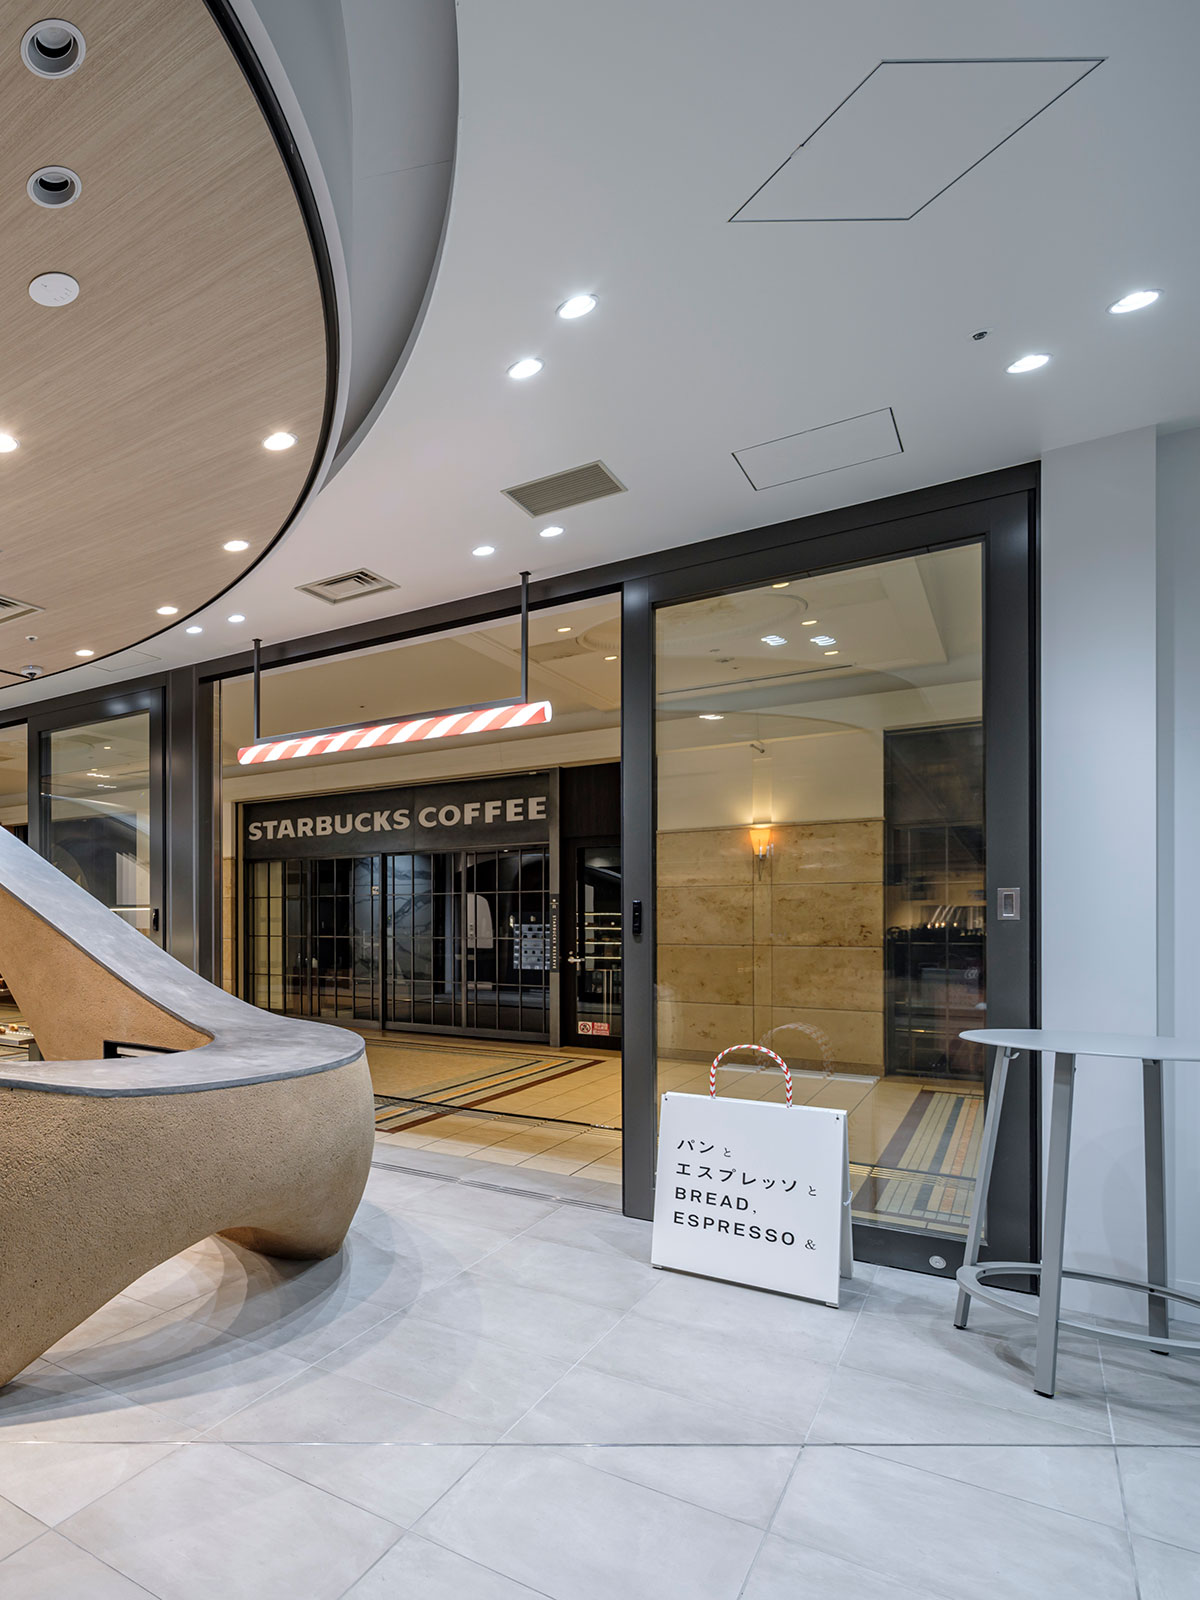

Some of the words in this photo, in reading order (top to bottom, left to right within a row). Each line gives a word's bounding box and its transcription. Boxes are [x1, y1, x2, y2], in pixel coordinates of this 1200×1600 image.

[248, 808, 410, 841] STARBUCKS
[418, 796, 546, 828] COFFEE
[675, 1187, 757, 1215] BREAD,
[674, 1212, 795, 1246] ESPRESSO
[805, 1239, 816, 1251] &
